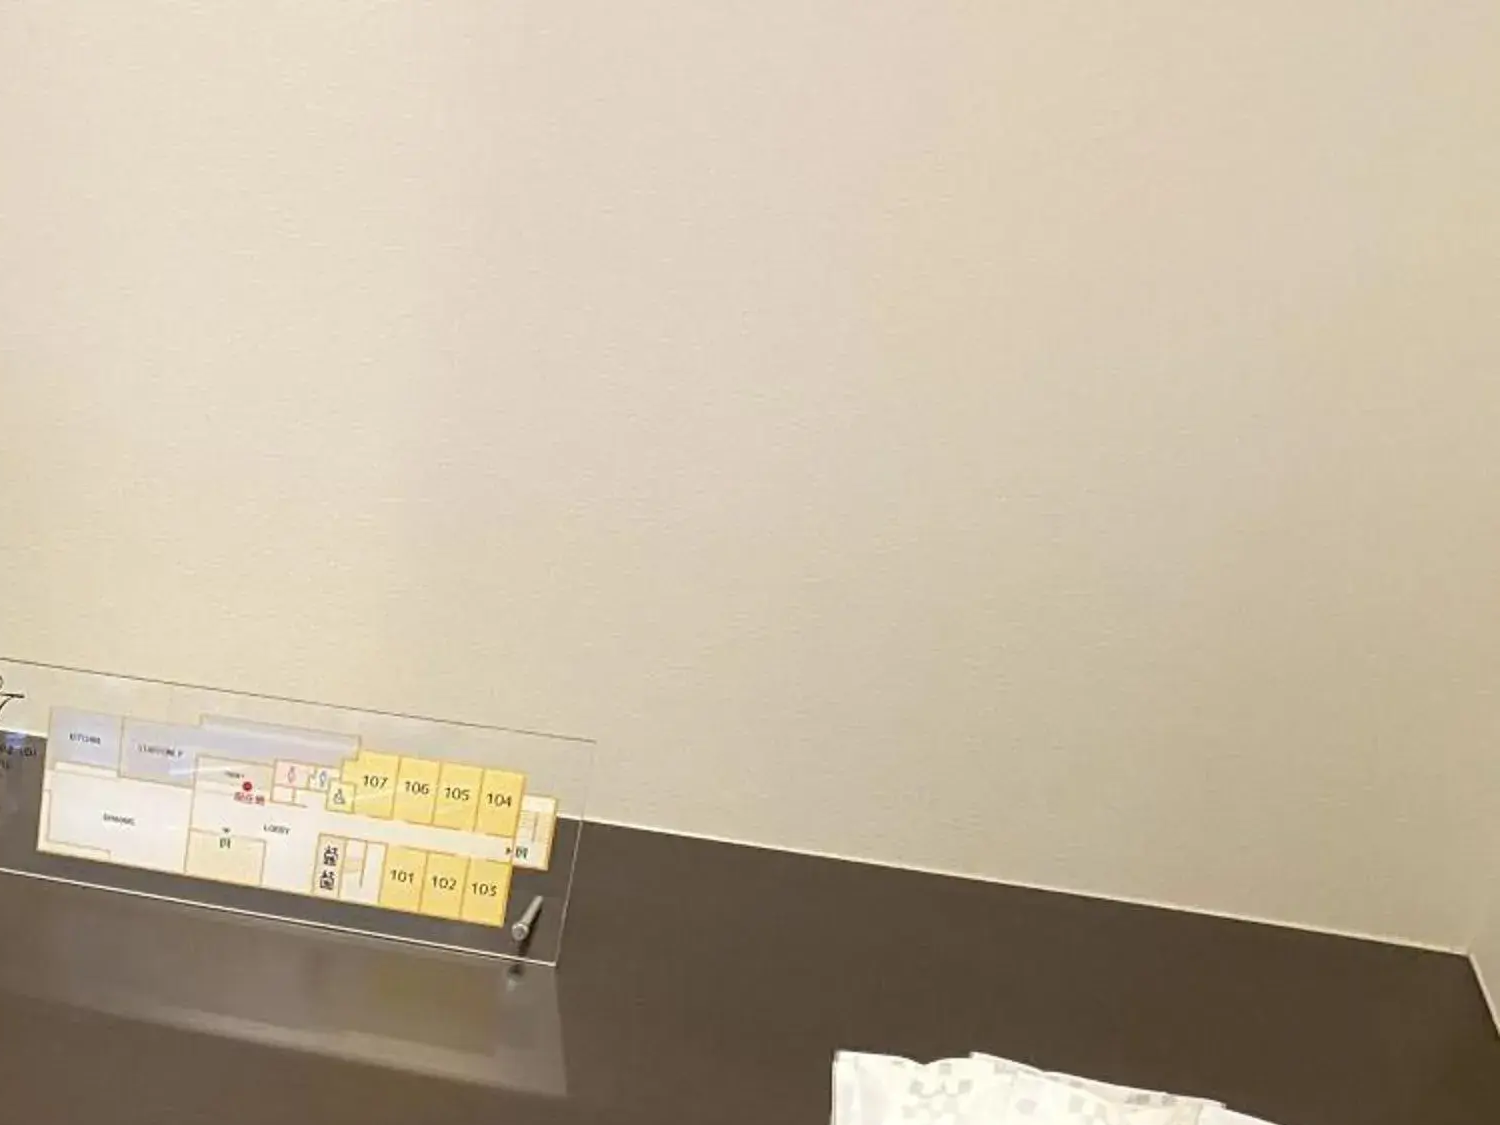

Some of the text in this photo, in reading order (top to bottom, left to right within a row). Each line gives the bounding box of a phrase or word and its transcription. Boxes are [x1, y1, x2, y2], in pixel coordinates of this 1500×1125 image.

[362, 774, 388, 790] 107
[404, 779, 430, 796] 106
[444, 785, 470, 802] 105
[486, 792, 513, 808] 104
[390, 868, 414, 885] 101
[432, 874, 457, 891] 102
[471, 881, 497, 897] 103
